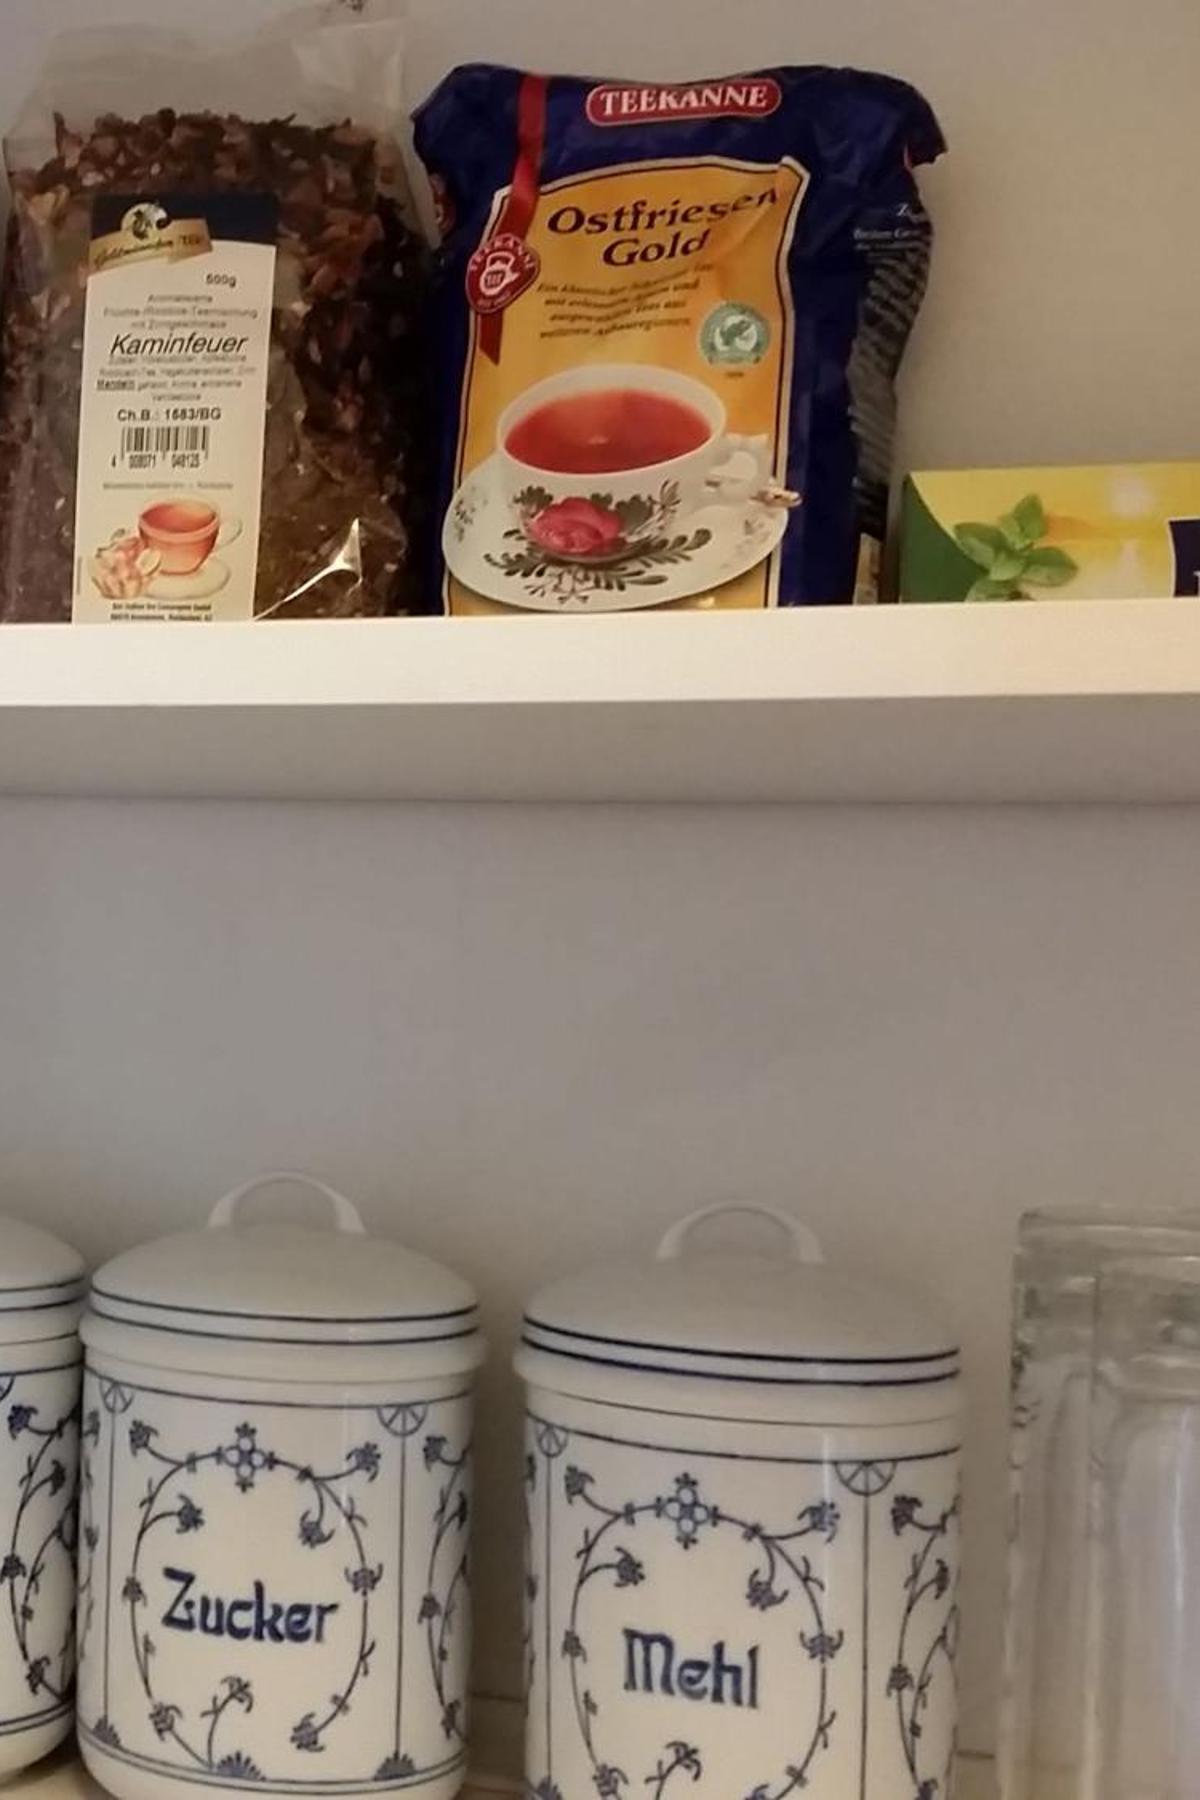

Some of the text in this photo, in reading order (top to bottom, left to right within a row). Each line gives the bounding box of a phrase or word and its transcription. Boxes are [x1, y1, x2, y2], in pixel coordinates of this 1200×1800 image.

[600, 85, 768, 115] TEEKANNE
[547, 188, 778, 235] Ostfriesen
[603, 228, 711, 267] Gold
[205, 273, 237, 288] 500g
[110, 332, 249, 356] Kaminfeuer
[162, 1567, 340, 1643] Zucker
[622, 1627, 760, 1709] Mehl
